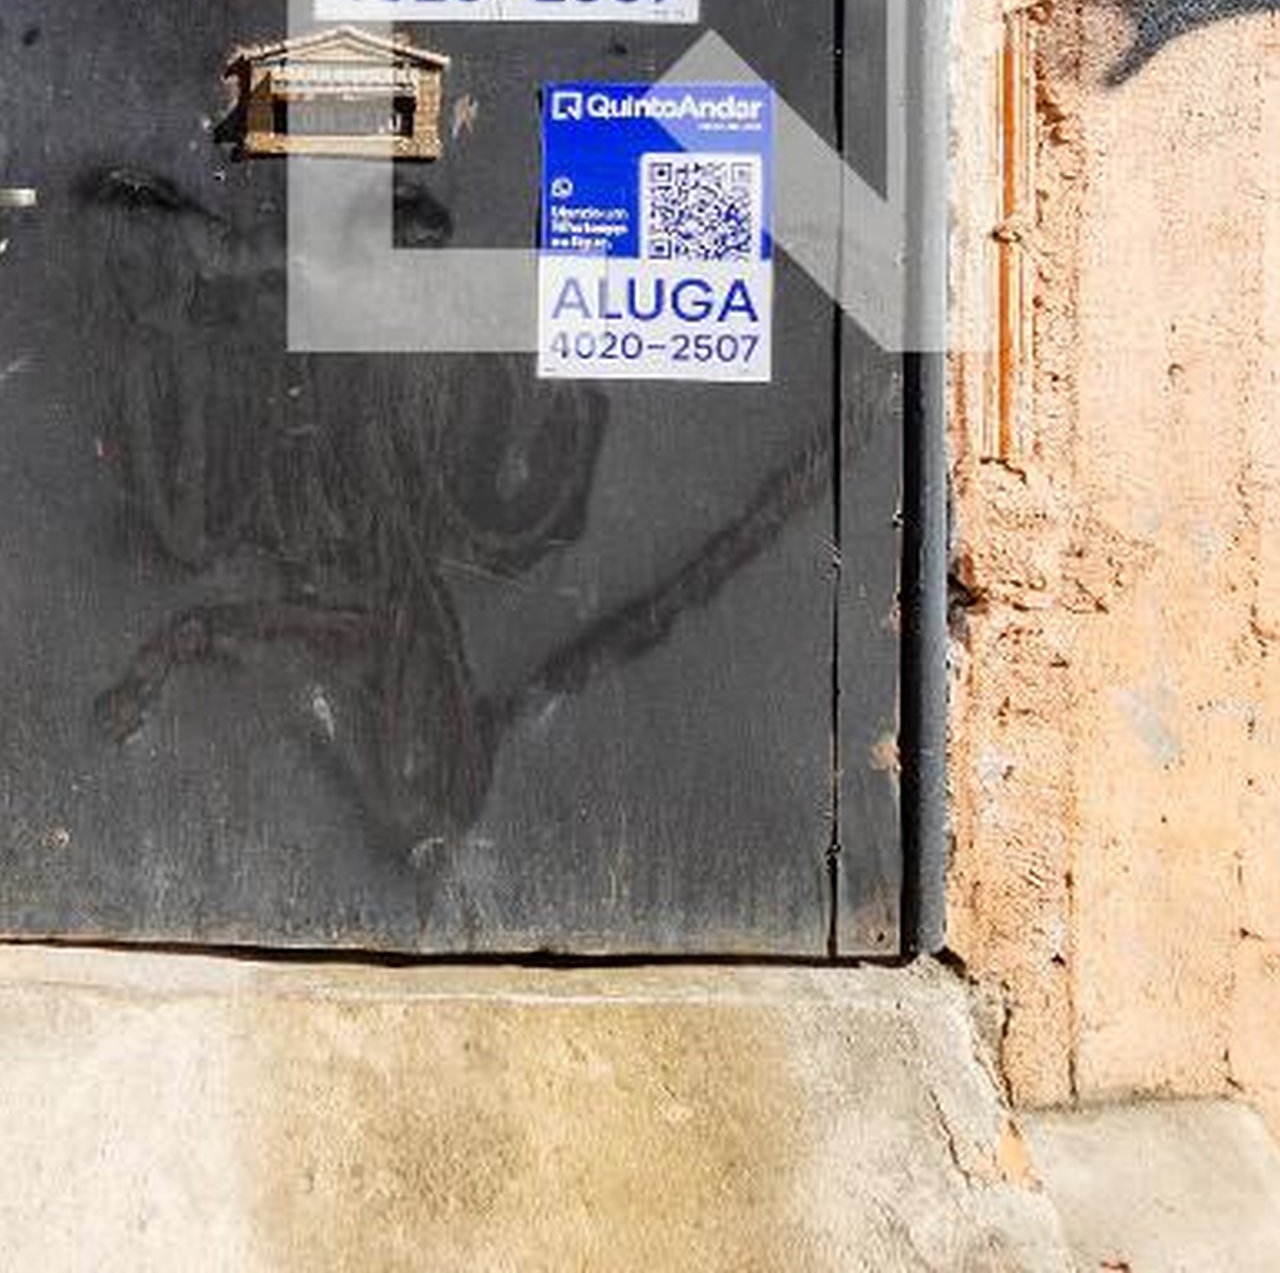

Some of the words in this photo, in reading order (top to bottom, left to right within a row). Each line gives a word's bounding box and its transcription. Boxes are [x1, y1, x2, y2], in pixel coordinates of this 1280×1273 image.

[586, 93, 763, 120] QuintoAndar
[552, 277, 759, 323] ALUGA
[551, 331, 760, 362] 4020-2507
